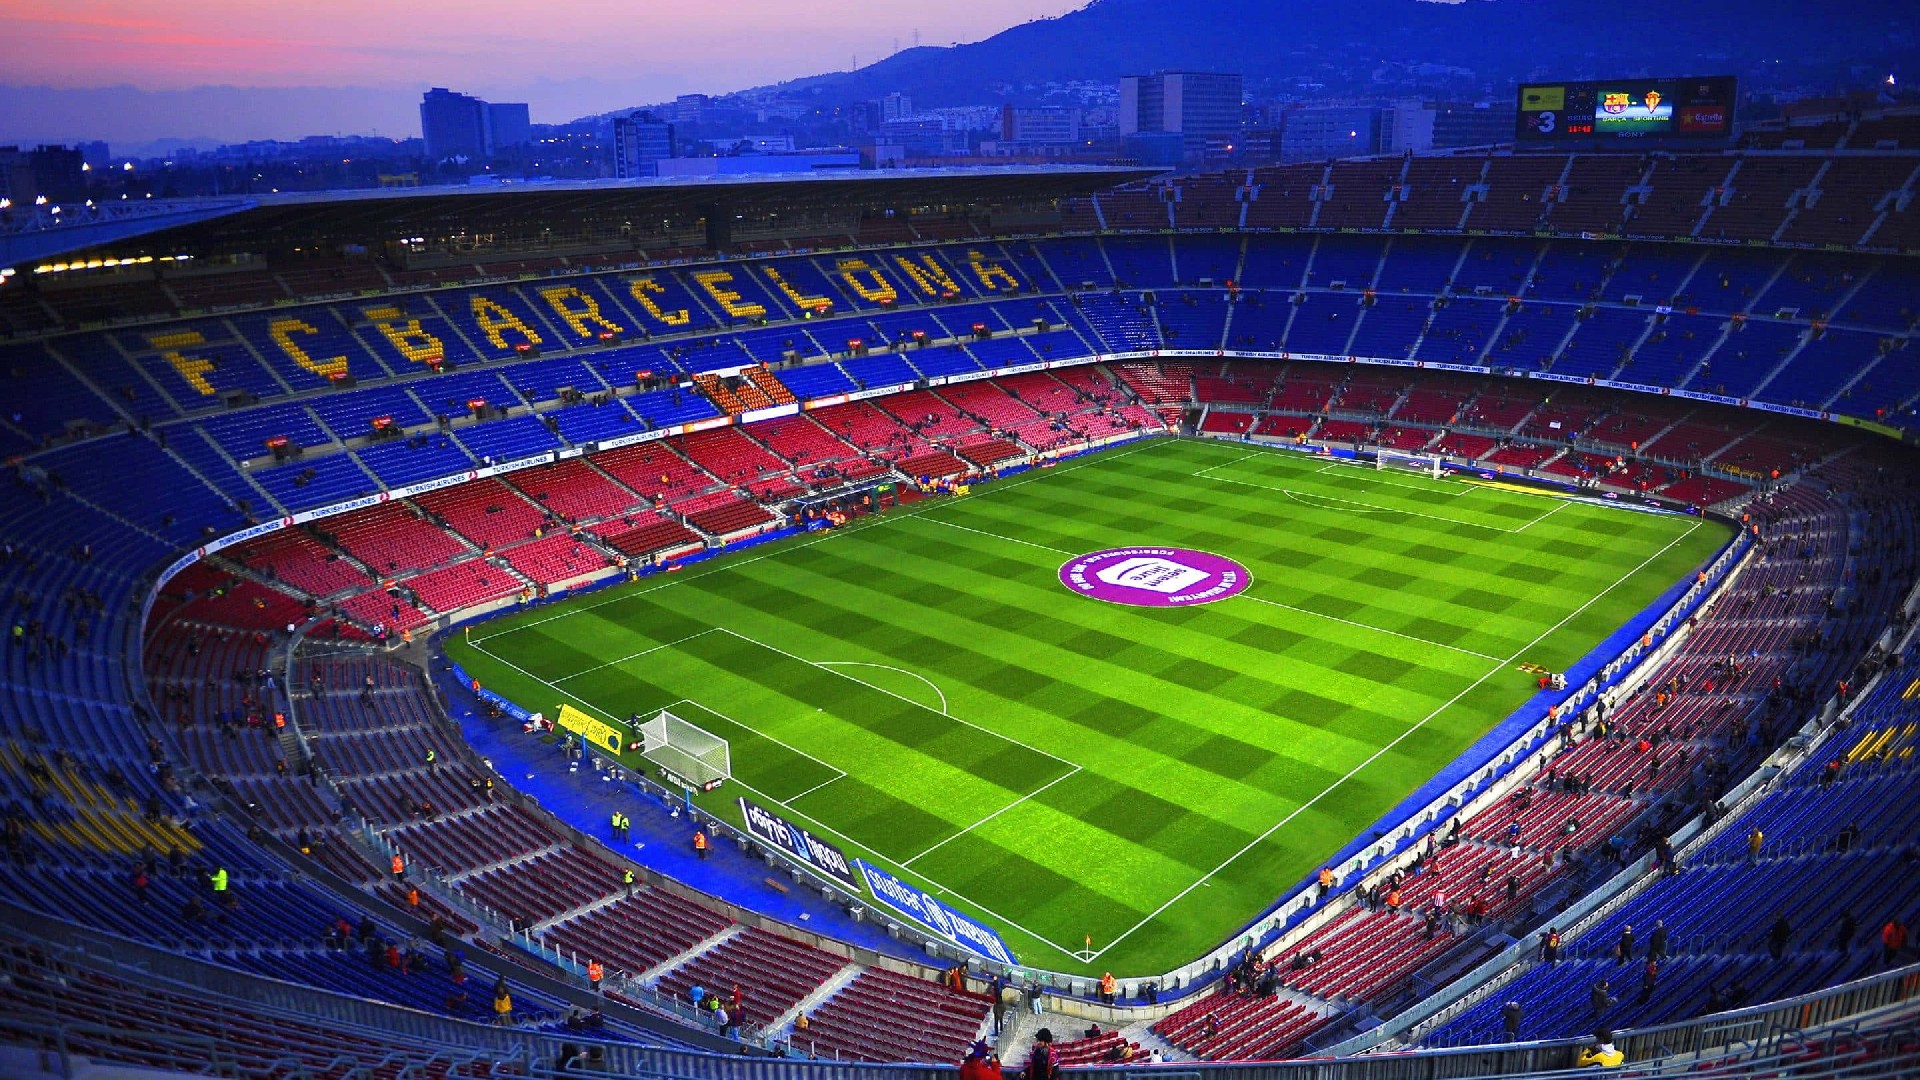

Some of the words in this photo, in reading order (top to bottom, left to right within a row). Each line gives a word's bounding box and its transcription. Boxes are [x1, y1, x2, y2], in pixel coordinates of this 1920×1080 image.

[612, 436, 636, 447] TURKISH
[636, 432, 660, 442] AIRLINES
[493, 463, 519, 473] TURKISH
[520, 456, 547, 467] AIRLINES
[406, 482, 435, 494] TURKISH
[436, 475, 465, 487] AIRLINES
[311, 505, 343, 518] TURKISH
[344, 496, 376, 510] AIRLINES
[219, 532, 246, 547] TURKISH
[247, 521, 280, 536] AIRLINES
[803, 830, 849, 875] mobily
[868, 868, 932, 922] Seguros
[945, 911, 1012, 964] Allianz
